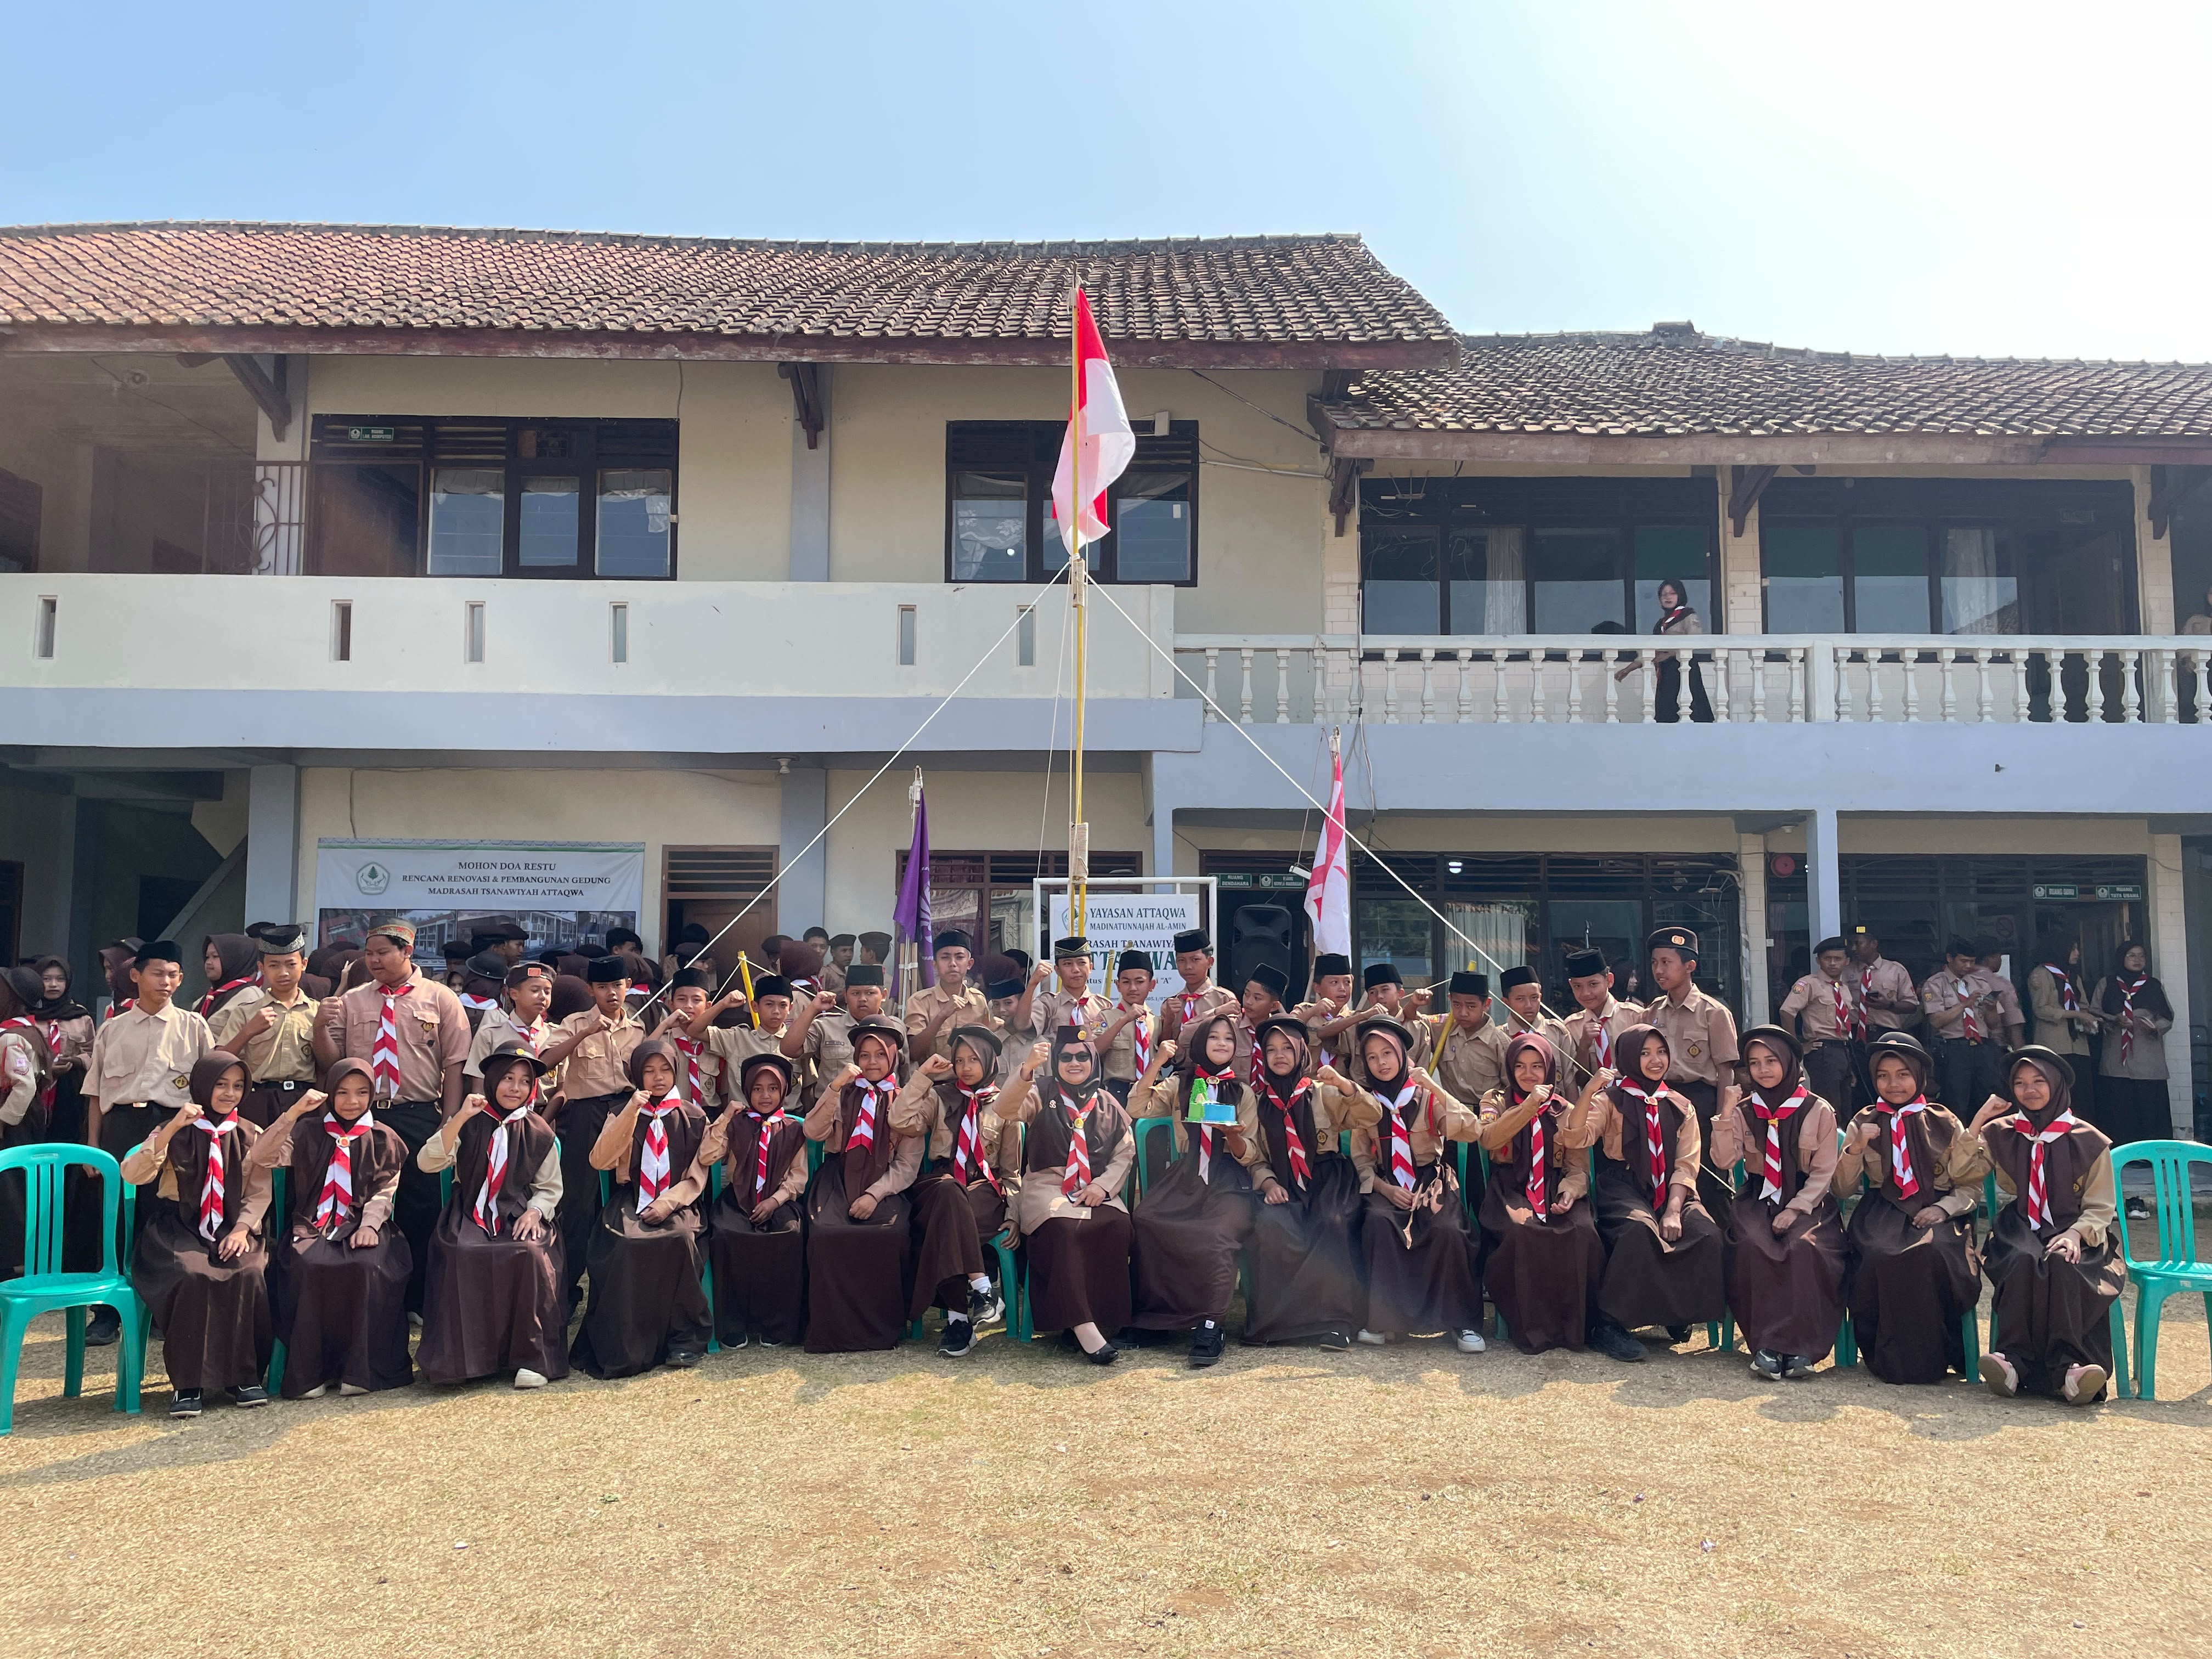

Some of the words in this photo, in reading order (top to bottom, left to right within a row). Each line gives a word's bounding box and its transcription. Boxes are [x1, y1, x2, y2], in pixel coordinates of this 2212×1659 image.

[458, 862, 497, 870] MOHON
[541, 889, 584, 897] ATTAQWA
[1090, 908, 1133, 918] YAYASAN
[1136, 907, 1186, 920] ATTAQWA
[1090, 923, 1154, 932] MADINATUNNAJAH
[1087, 940, 1118, 948] RASAH
